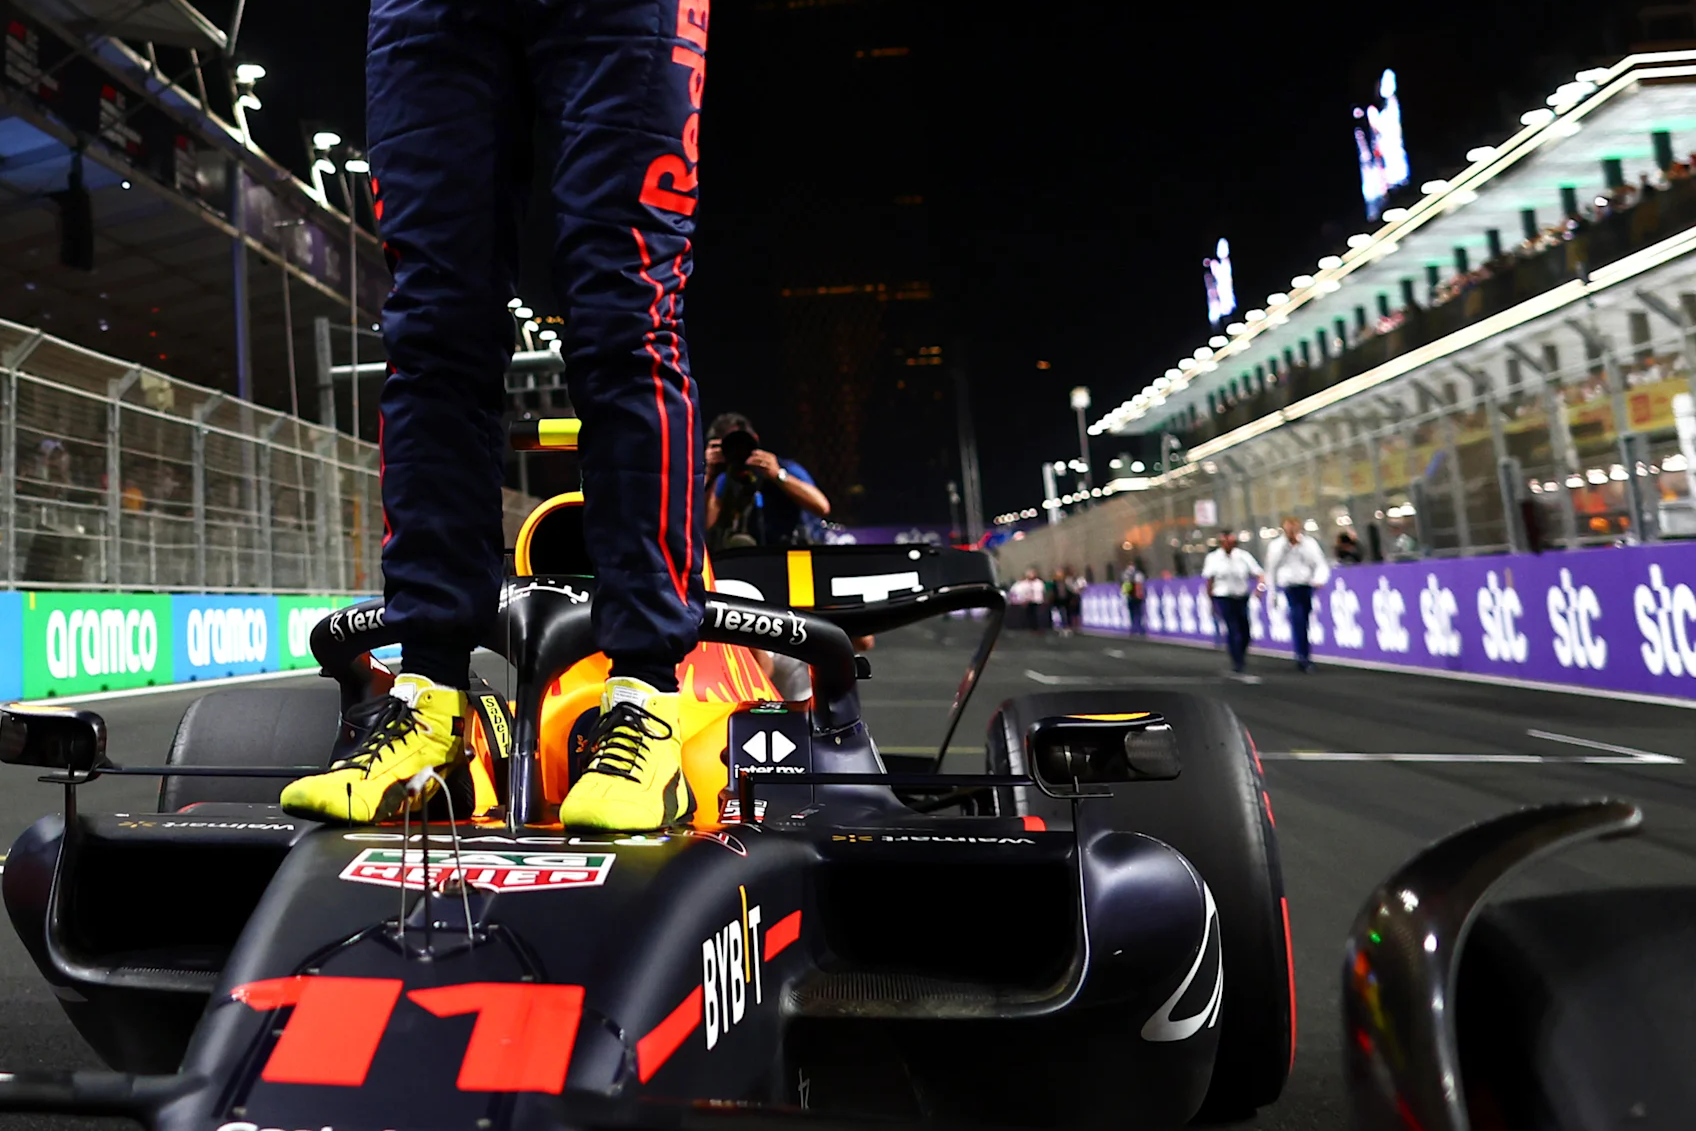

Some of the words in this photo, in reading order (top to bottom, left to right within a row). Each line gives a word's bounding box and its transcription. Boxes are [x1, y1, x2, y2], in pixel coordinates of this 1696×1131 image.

[46, 608, 157, 678] aramco
[187, 608, 267, 667] aramco
[346, 608, 386, 634] Tezo
[710, 600, 784, 638] Tezos
[1477, 570, 1529, 663] stc
[1547, 567, 1608, 670] stc
[485, 698, 509, 756] Sabelt
[381, 851, 589, 867] TAG
[702, 884, 761, 1051] BYBIT
[230, 975, 586, 1095] 11
